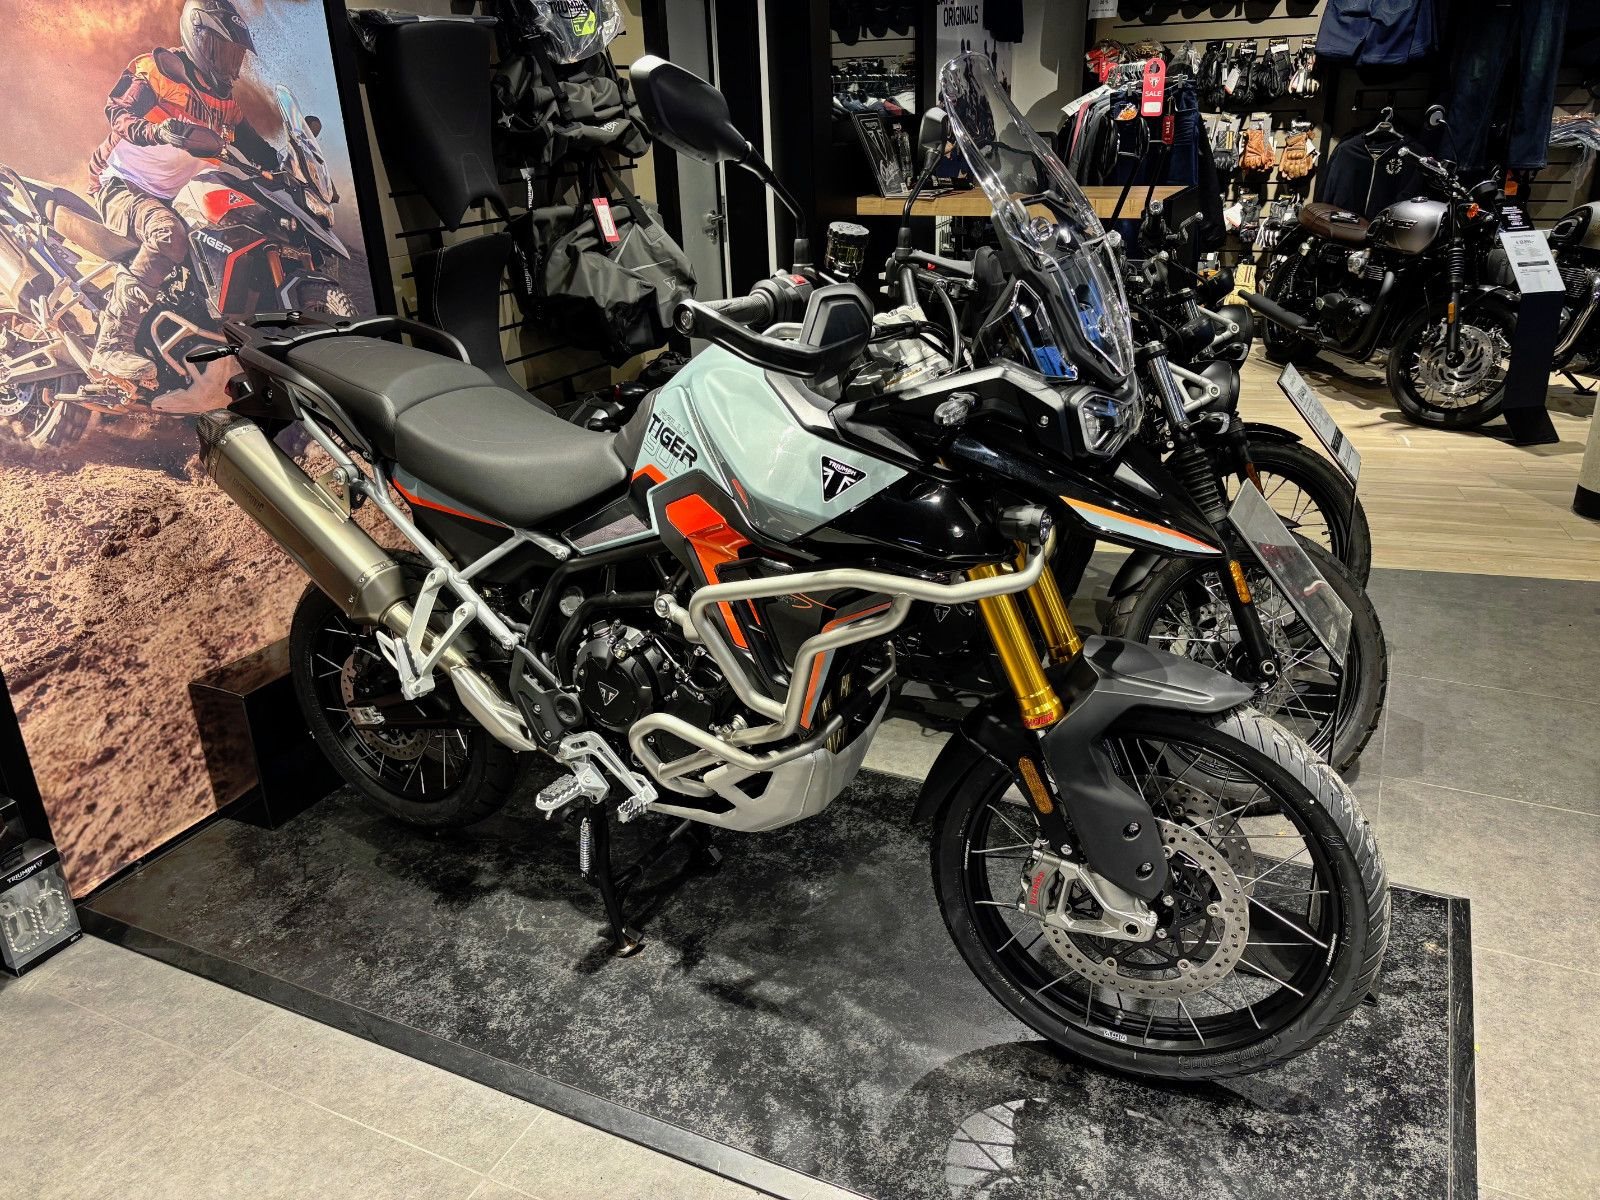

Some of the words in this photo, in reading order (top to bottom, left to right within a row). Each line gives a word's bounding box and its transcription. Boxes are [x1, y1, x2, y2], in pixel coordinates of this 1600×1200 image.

[943, 5, 979, 27] ORIGINALS
[197, 230, 233, 255] TIGER
[648, 412, 698, 469] TIGER
[829, 460, 858, 477] TRIUMPH
[6, 864, 37, 884] TRIUMPH
